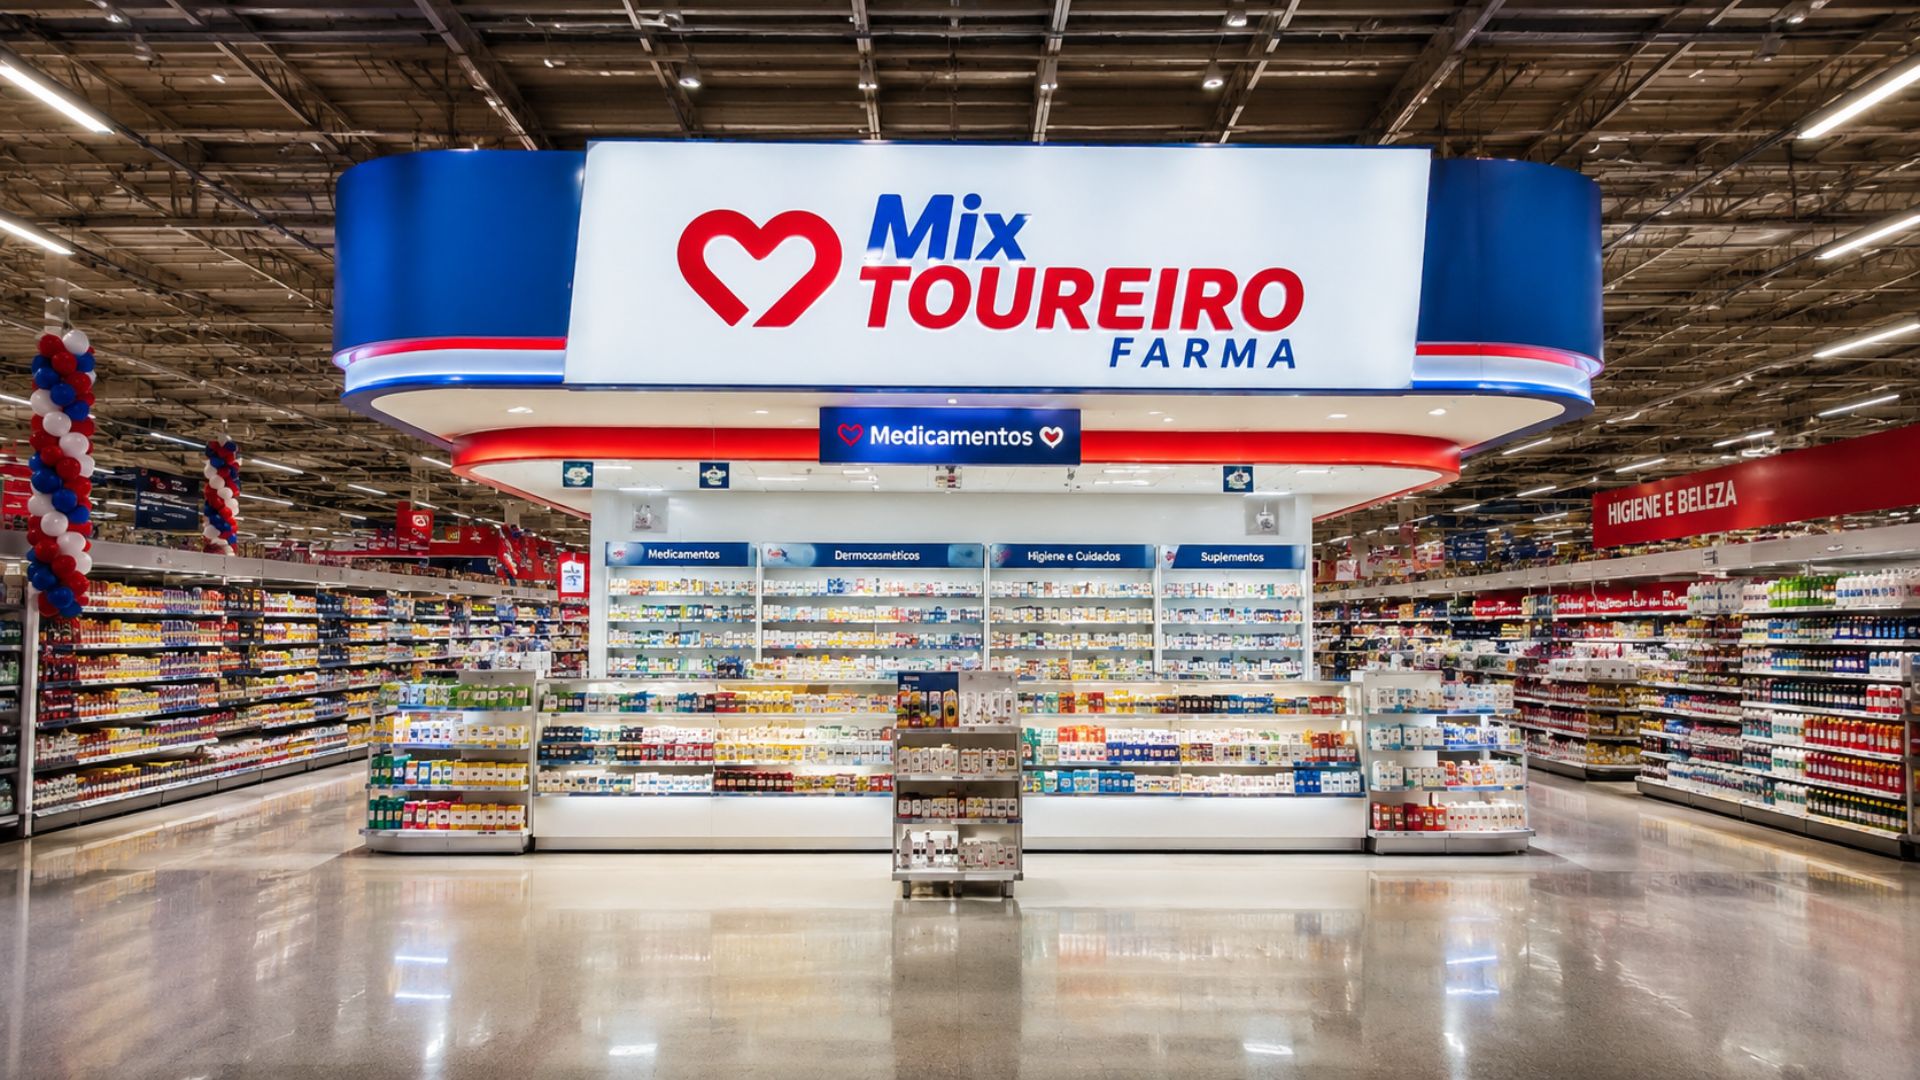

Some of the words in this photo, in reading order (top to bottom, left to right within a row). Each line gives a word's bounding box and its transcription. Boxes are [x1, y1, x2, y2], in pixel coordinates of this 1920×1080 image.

[866, 192, 1029, 261] Mix
[860, 266, 1305, 332] TOUREIRO
[1110, 336, 1296, 369] FARMA
[870, 425, 1033, 446] Medicamentos
[1608, 493, 1662, 526] HIGIENE
[1665, 491, 1674, 516] E
[1677, 480, 1737, 514] BELEZA
[648, 549, 720, 560] Medicamentos
[1027, 551, 1066, 563] Higiene
[1066, 553, 1074, 561] e
[1075, 551, 1121, 562] Cuidados
[1201, 551, 1265, 564] Suplementos
